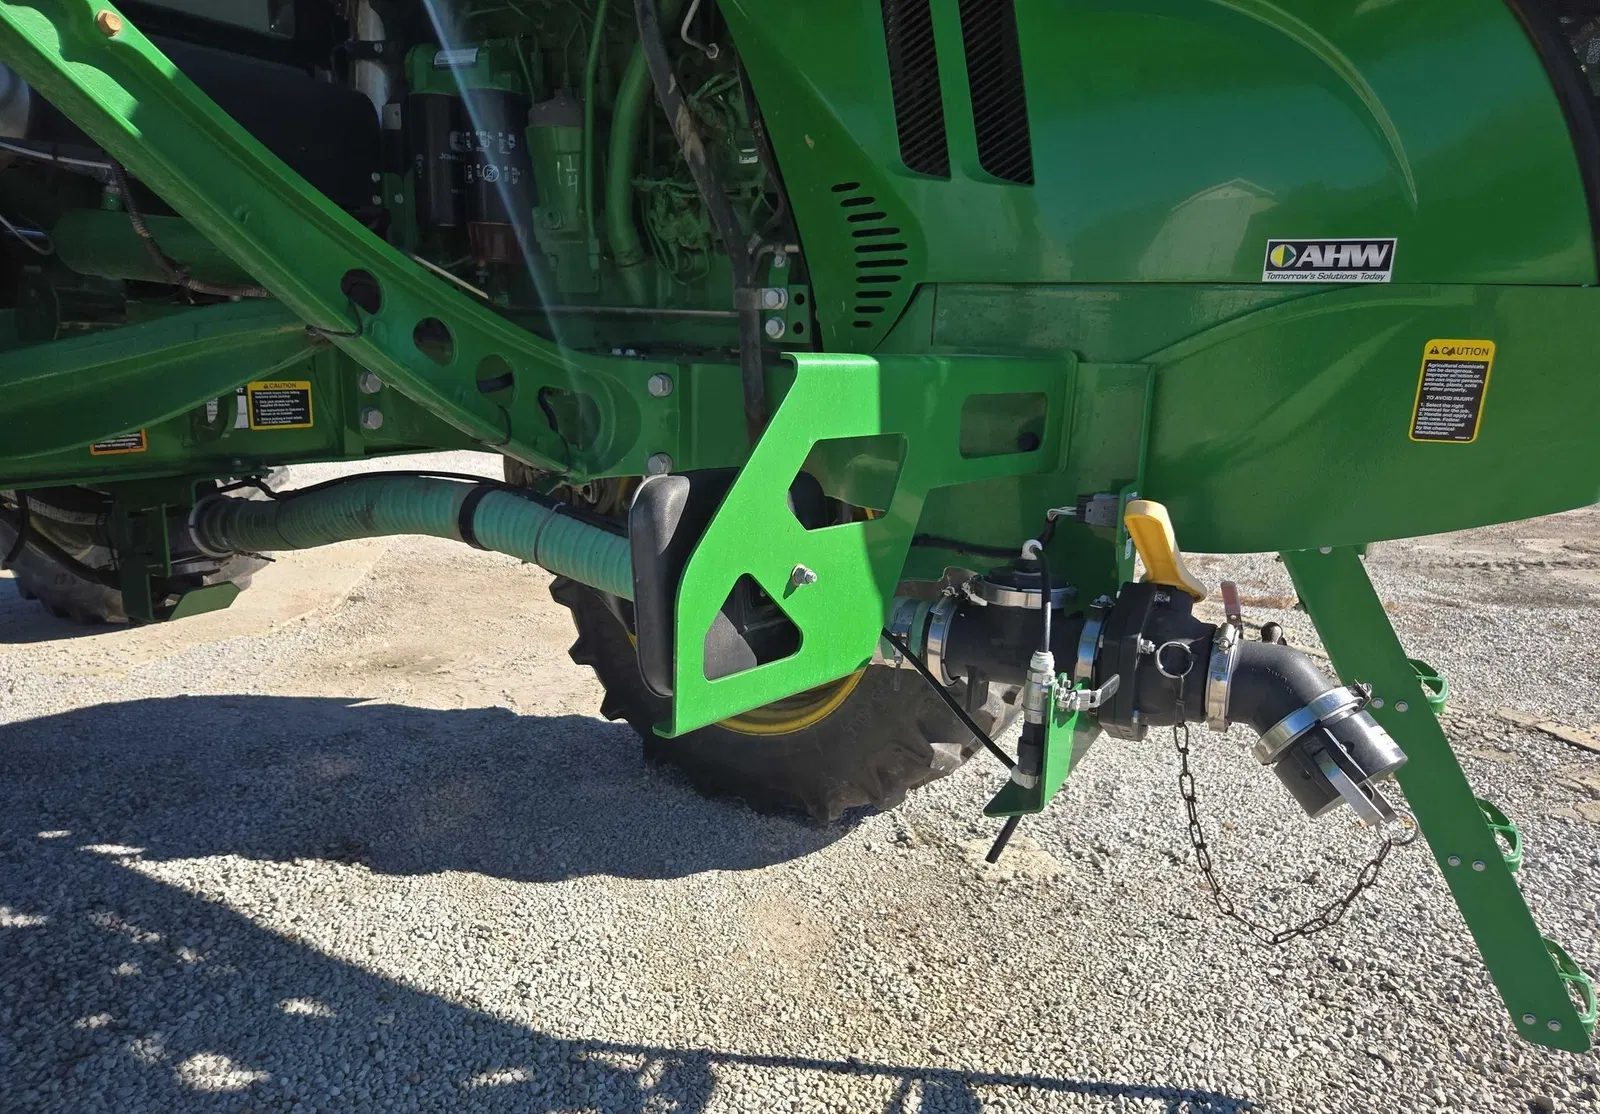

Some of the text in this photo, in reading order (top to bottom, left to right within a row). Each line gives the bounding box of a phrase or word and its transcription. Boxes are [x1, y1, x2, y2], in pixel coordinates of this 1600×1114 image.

[1295, 244, 1390, 268] AHW
[1360, 273, 1385, 281] Today
[1442, 346, 1489, 356] CAUTION
